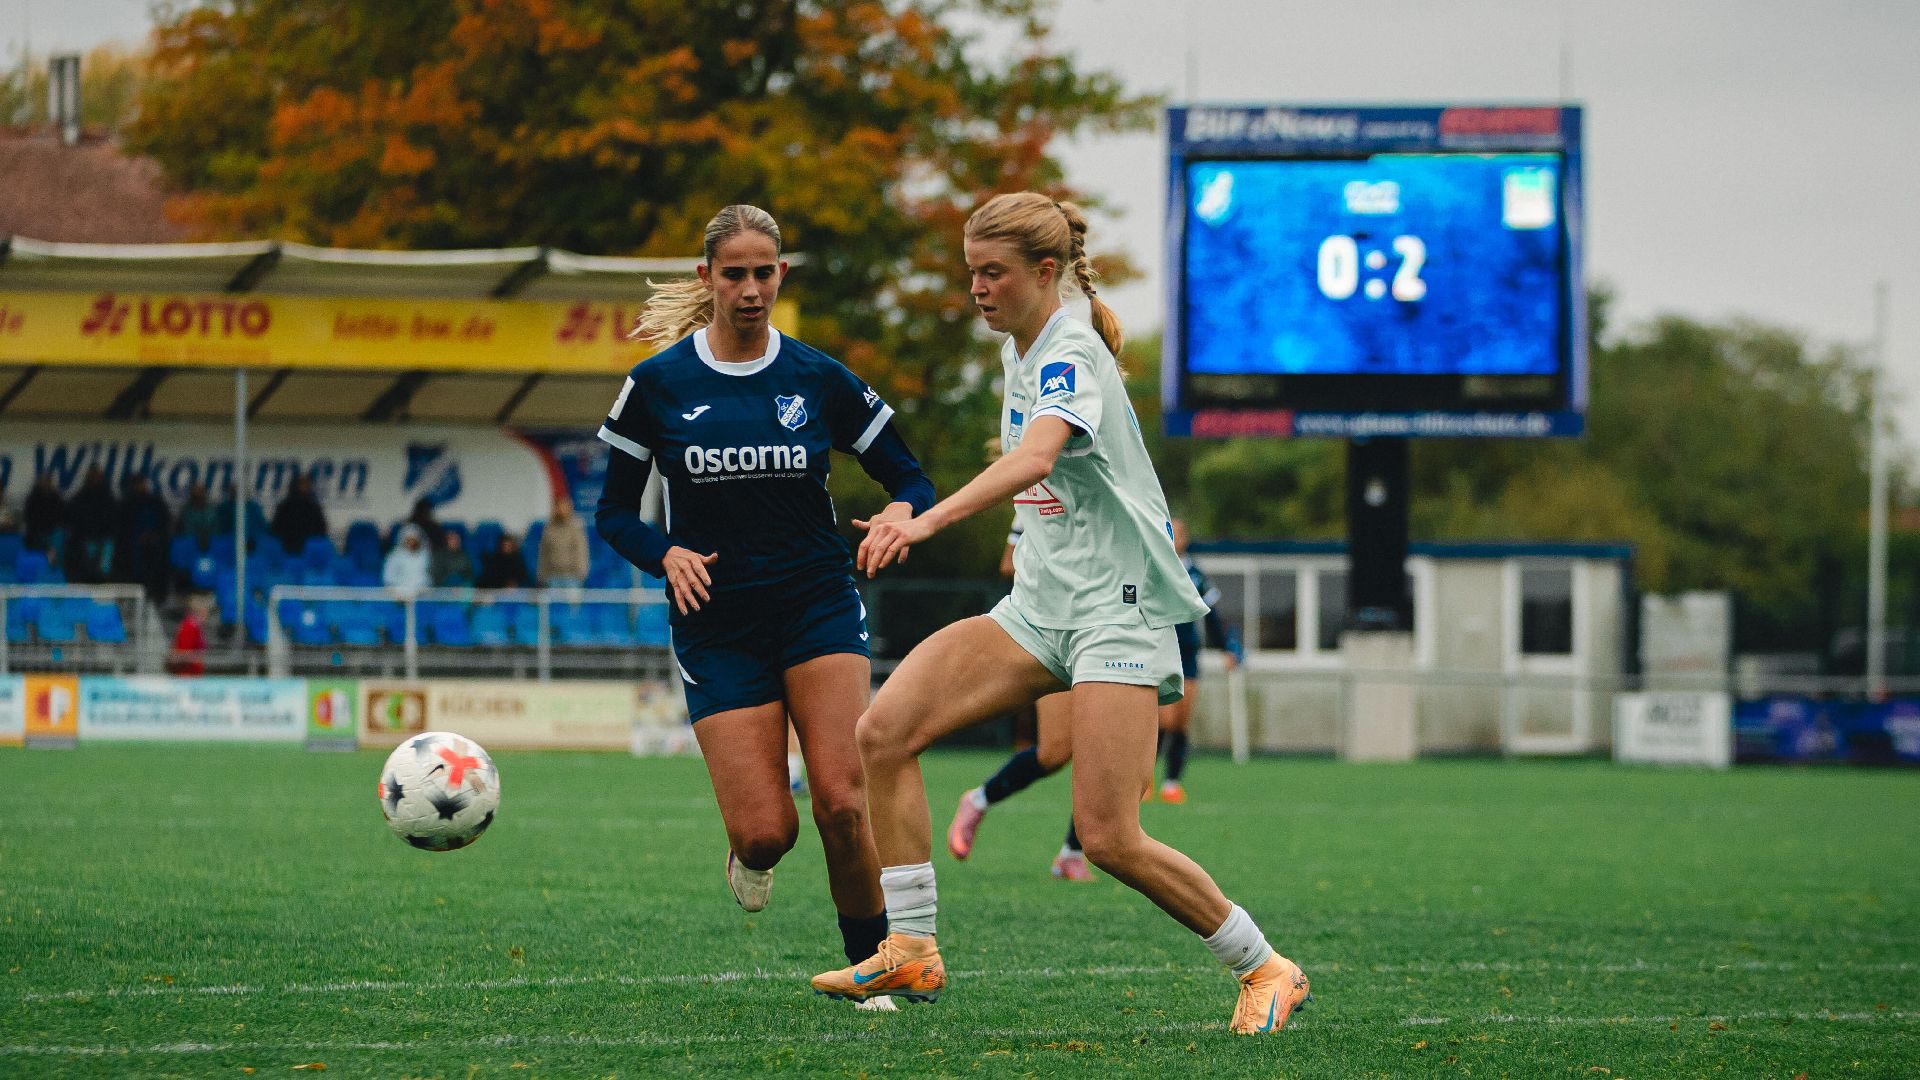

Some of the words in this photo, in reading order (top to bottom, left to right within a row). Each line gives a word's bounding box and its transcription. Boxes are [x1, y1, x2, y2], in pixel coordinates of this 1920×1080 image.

[139, 299, 272, 338] LOTTO
[1041, 375, 1069, 396] AXA
[684, 445, 807, 474] Oscorna
